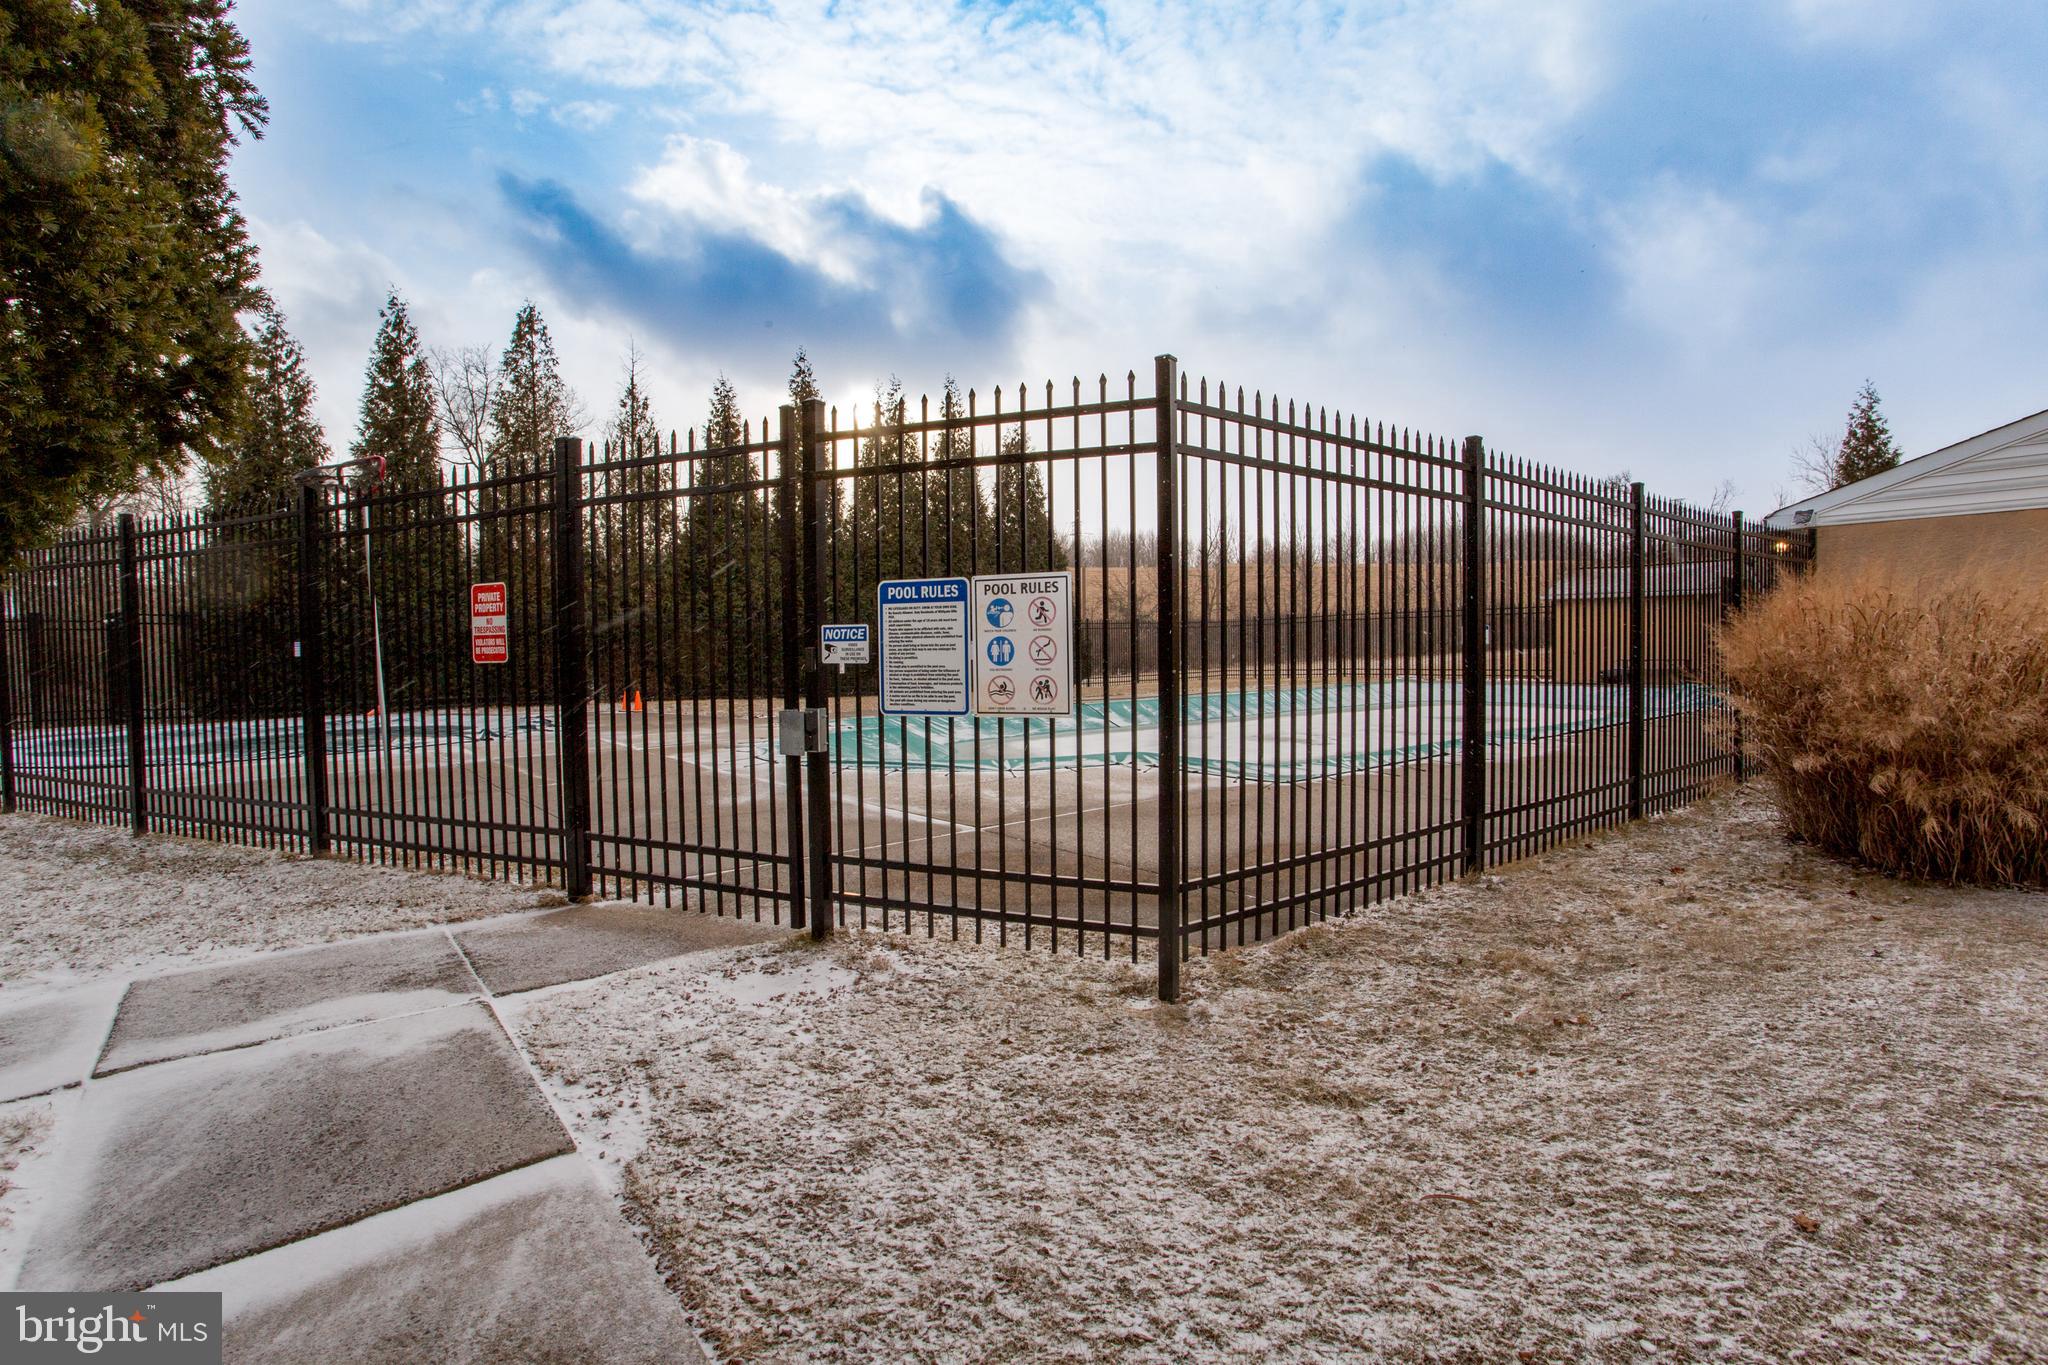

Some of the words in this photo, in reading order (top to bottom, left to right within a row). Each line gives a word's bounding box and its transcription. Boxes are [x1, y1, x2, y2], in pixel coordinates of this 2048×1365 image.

[888, 586, 918, 600] POOL
[921, 584, 959, 598] RULES
[984, 583, 1016, 596] POOL
[1020, 581, 1059, 594] RULES
[477, 592, 501, 603] PRIVATE
[474, 602, 504, 613] PROPERTY
[474, 625, 506, 634] TRESPASSING
[825, 628, 866, 640] NOTICE
